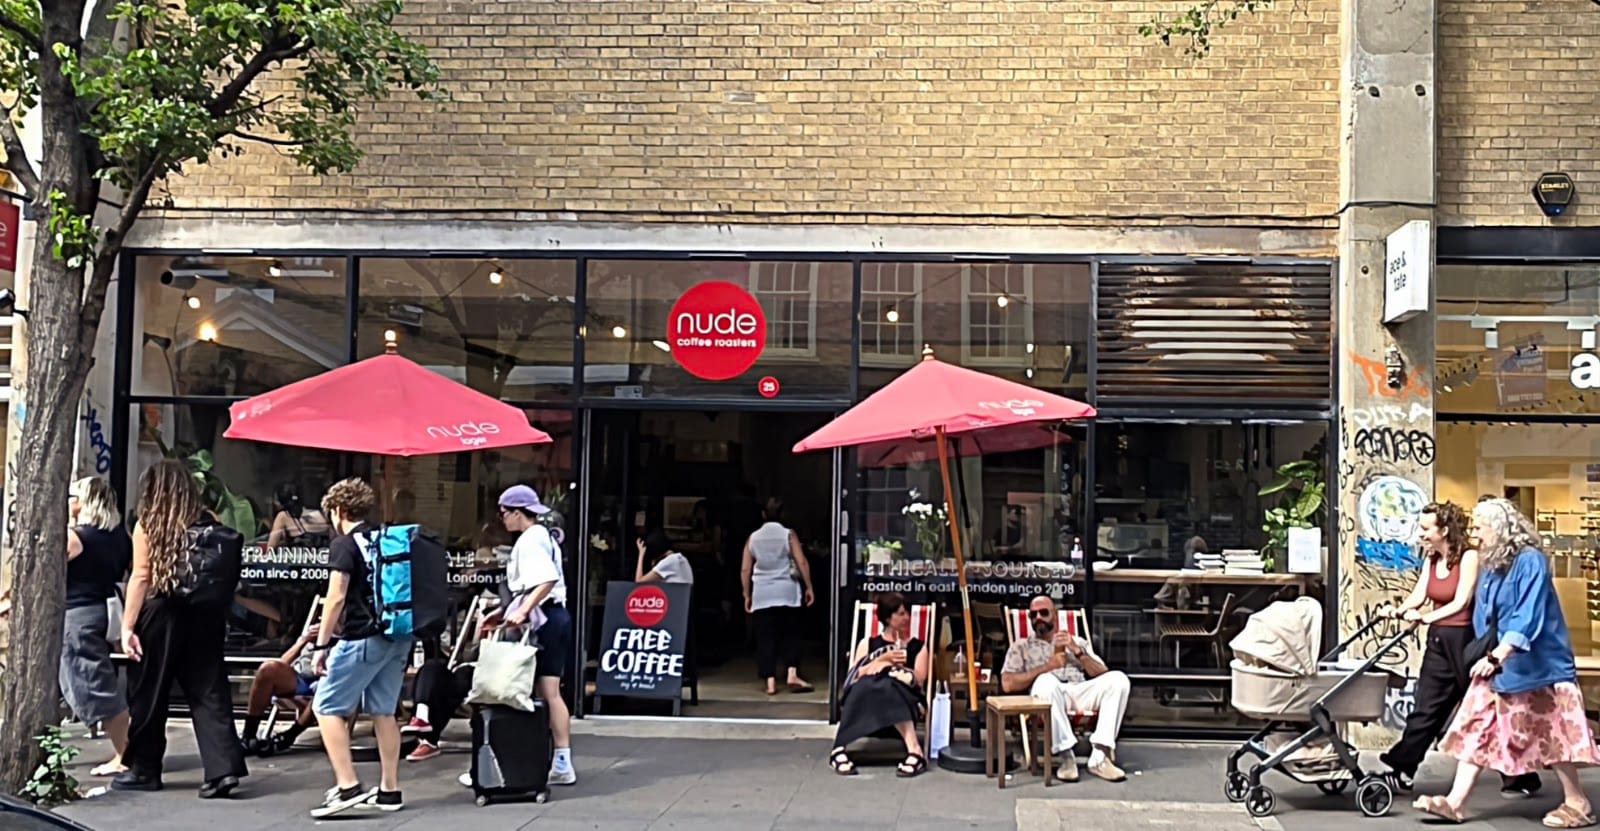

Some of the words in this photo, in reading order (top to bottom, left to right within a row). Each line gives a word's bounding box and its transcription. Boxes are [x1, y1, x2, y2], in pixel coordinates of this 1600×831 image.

[677, 308, 757, 334] nude
[677, 337, 712, 346] coffee
[715, 338, 757, 347] roasters
[427, 422, 500, 438] nude
[242, 547, 330, 564] TRAINING
[241, 567, 264, 579] don
[267, 568, 298, 579] since
[301, 568, 328, 579] 2008
[447, 573, 493, 583] London
[863, 581, 912, 592] roasted
[915, 582, 926, 592] in
[929, 582, 956, 592] east
[959, 583, 1007, 594] ondon
[1009, 583, 1042, 594] since
[629, 597, 664, 608] nude
[613, 628, 672, 651] FREE
[601, 649, 684, 676] COFFEE
